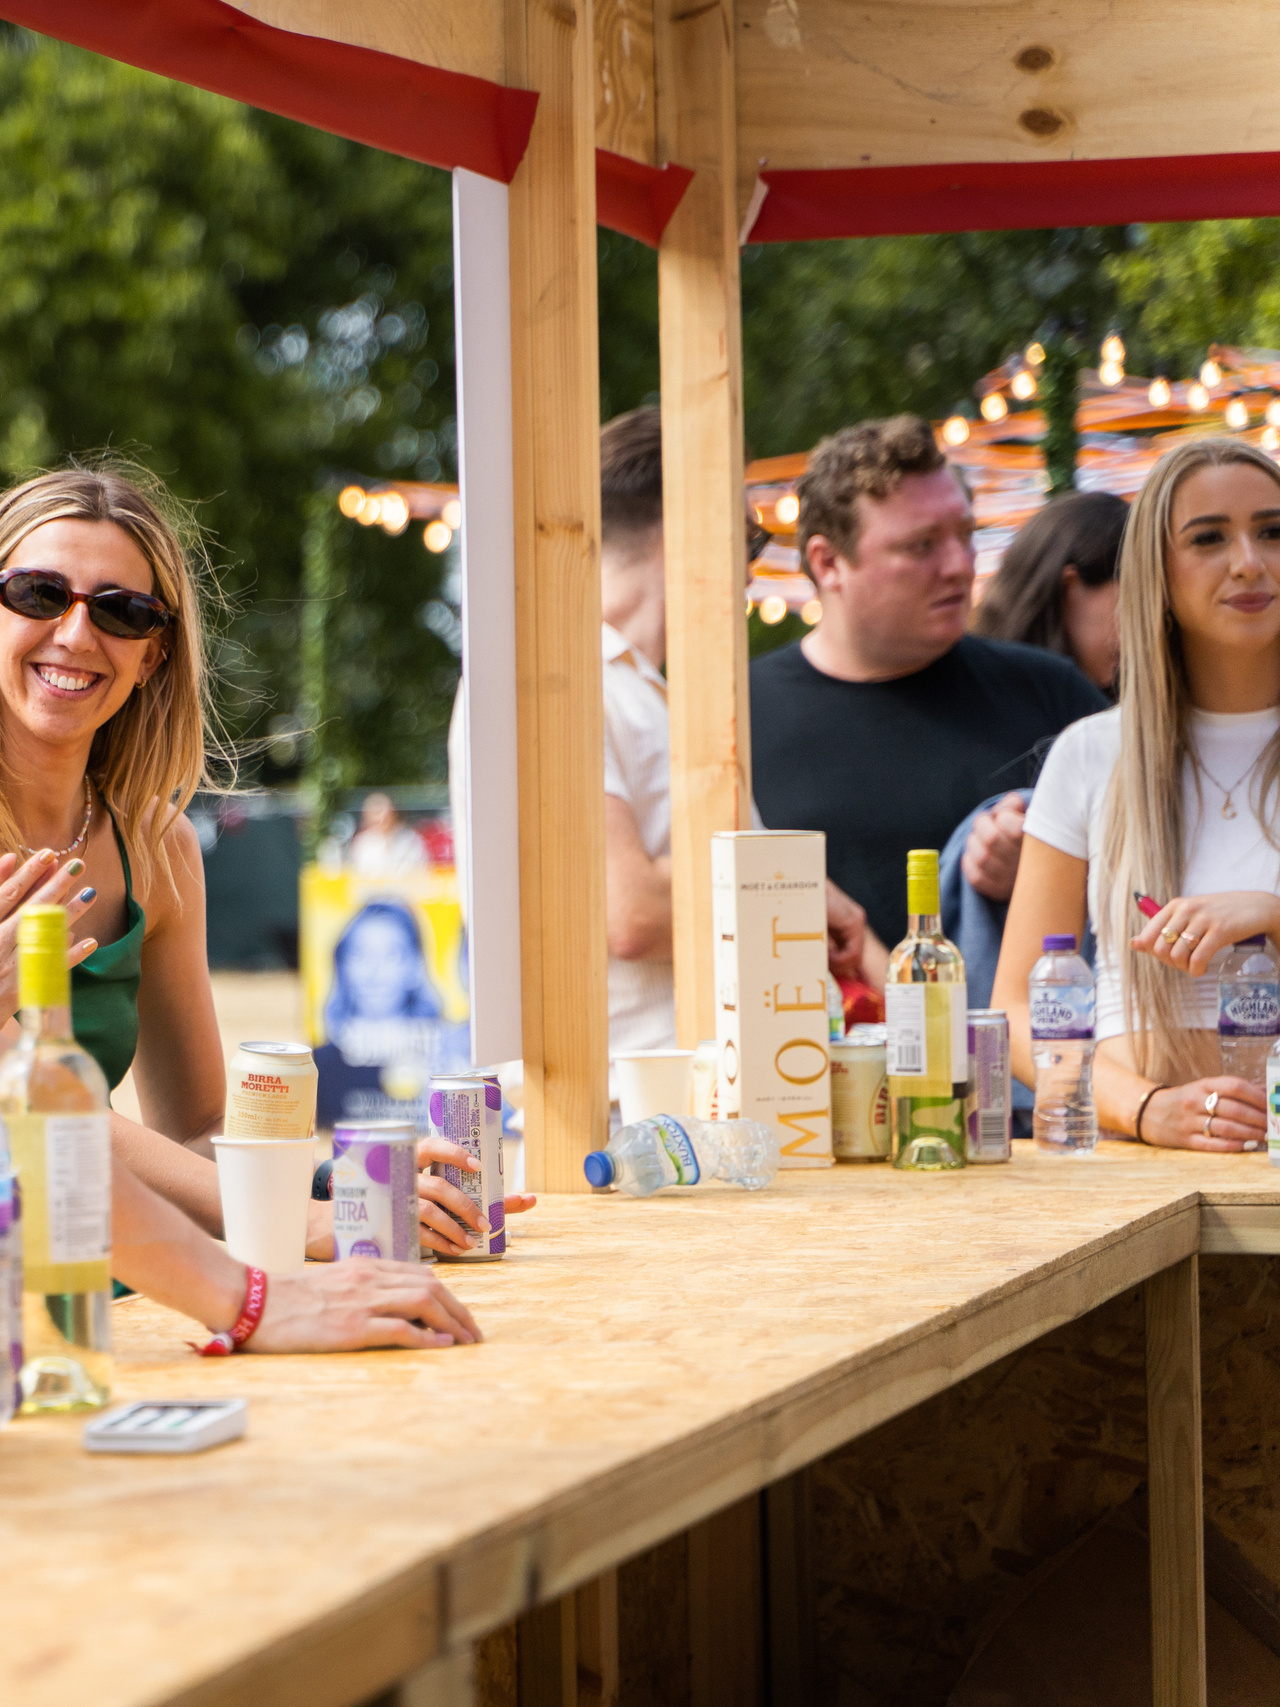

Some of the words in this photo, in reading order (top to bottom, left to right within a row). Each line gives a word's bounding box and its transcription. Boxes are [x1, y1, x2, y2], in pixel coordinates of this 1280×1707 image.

[763, 916, 832, 1159] MOËT
[248, 1073, 282, 1085] BIRRA
[241, 1081, 289, 1094] MORETTI
